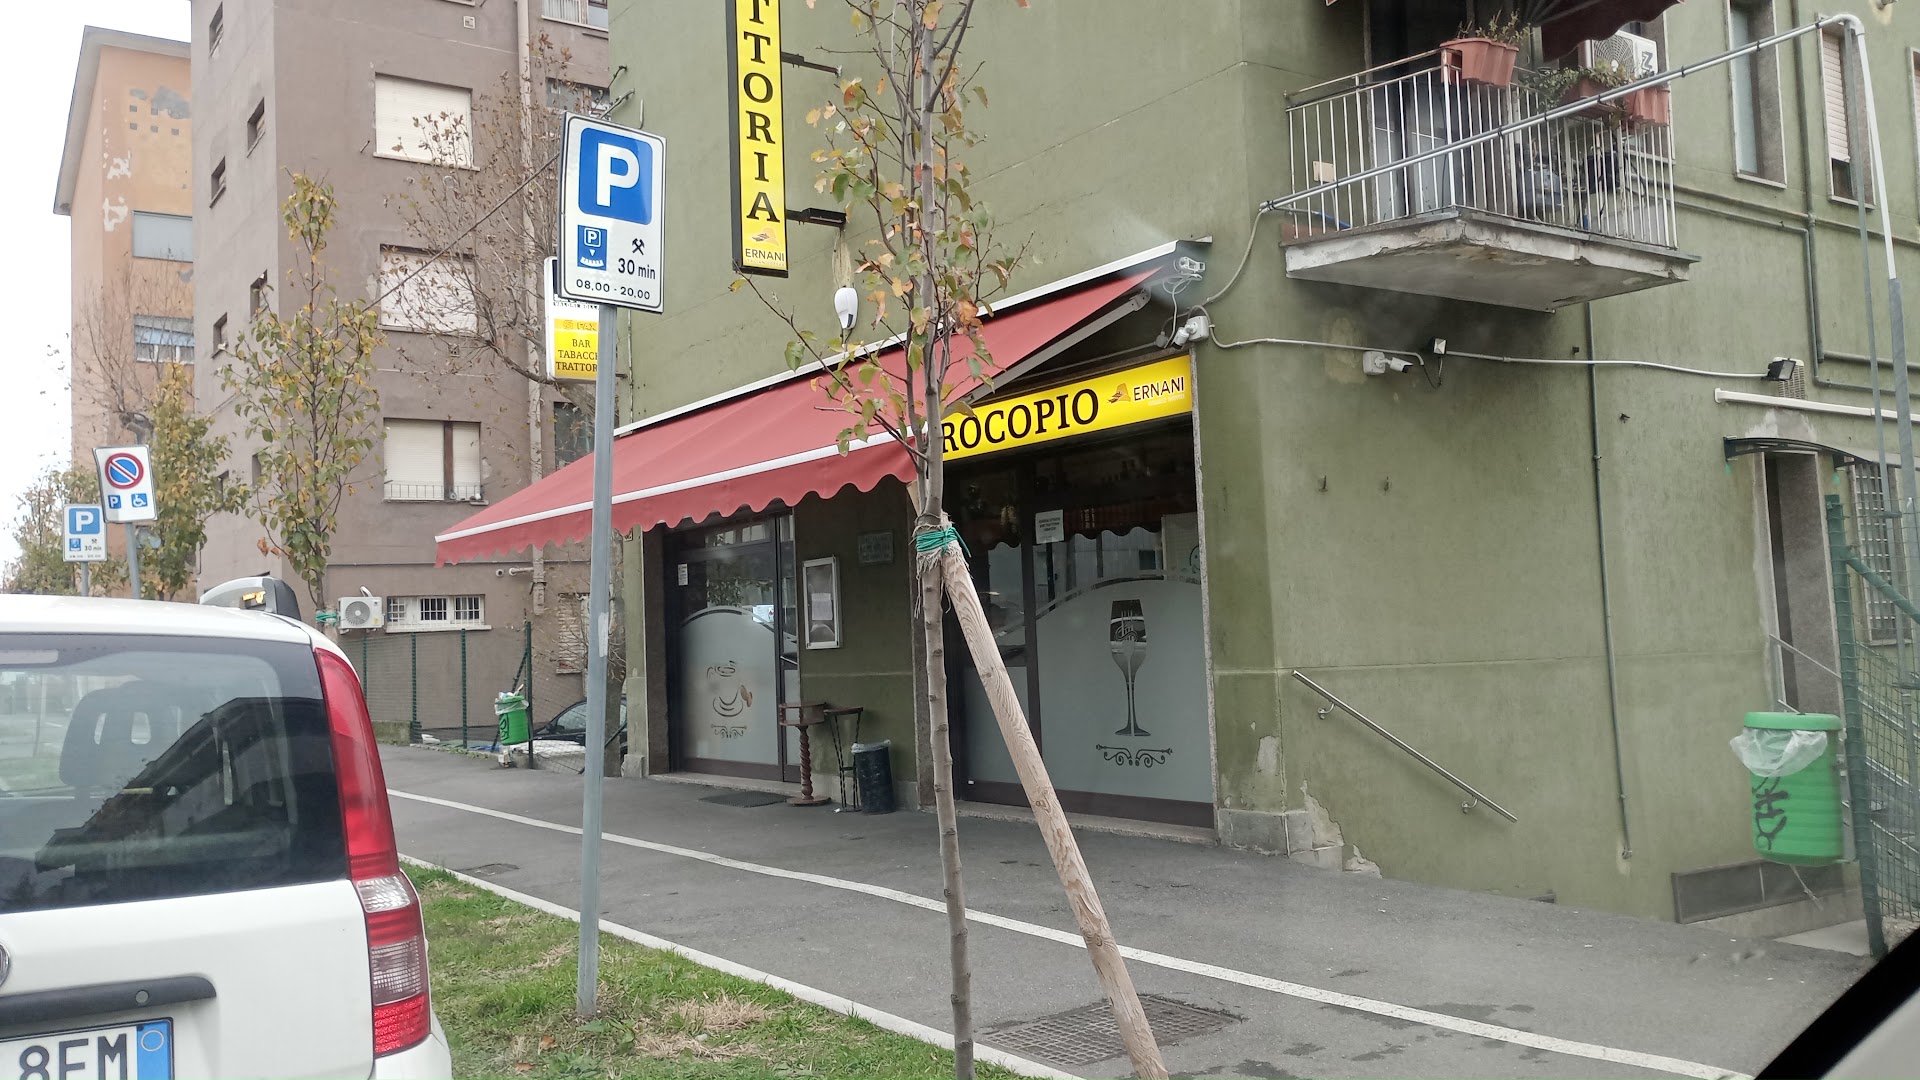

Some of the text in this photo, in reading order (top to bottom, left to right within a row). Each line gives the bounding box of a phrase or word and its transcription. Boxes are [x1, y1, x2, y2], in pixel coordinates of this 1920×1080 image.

[596, 142, 640, 207] P
[587, 231, 597, 244] P
[745, 248, 785, 262] ERNANI
[618, 257, 656, 280] 30 min
[576, 278, 610, 293] 08.00
[620, 286, 651, 300] 20.00
[572, 339, 591, 348] BAR
[1133, 376, 1185, 401] ERNANI
[942, 388, 1099, 453] ROCOPIO
[110, 496, 119, 508] P
[75, 511, 94, 532] P
